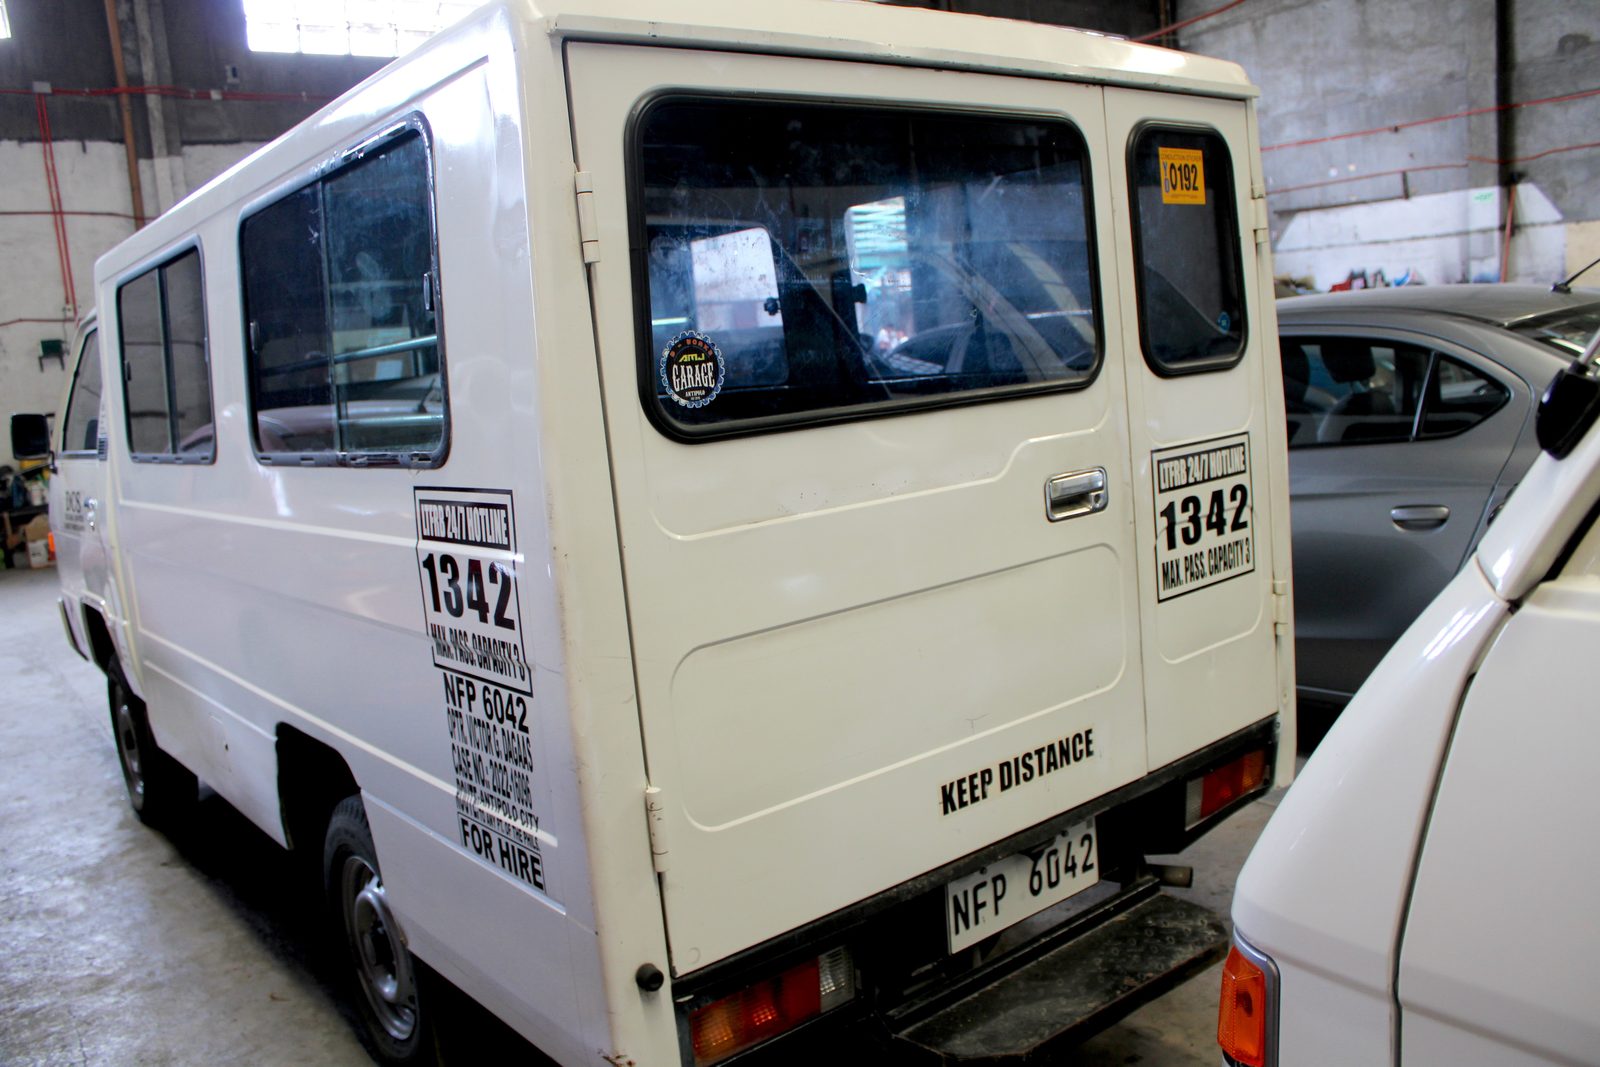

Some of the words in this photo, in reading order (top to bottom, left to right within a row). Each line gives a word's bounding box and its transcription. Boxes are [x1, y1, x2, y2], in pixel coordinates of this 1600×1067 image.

[1170, 162, 1199, 191] 0192
[672, 362, 715, 392] GARAGE
[1161, 458, 1187, 490] LTFRB
[1187, 453, 1209, 484] 24/7
[1209, 445, 1245, 479] HOTLINE
[421, 503, 447, 538] LTFRB
[446, 505, 467, 541] 24/7
[466, 506, 509, 545] HOTLINE
[1160, 483, 1248, 551] 1342
[422, 552, 516, 631] 1342
[1162, 558, 1184, 591] MAX.
[1184, 551, 1207, 584] PASS.
[1208, 538, 1244, 576] CAPACITY
[1245, 537, 1251, 564] 3
[430, 623, 454, 659] MAX.
[472, 633, 519, 679] CAPACITY
[443, 672, 476, 713] NFP
[482, 685, 530, 735] 6042
[451, 742, 473, 781] CASE
[466, 714, 495, 756] VICTOR
[501, 727, 534, 773] DAGAAS
[941, 767, 993, 816] KEEP
[998, 728, 1095, 793] DISTANCE
[480, 789, 519, 823] ANTIPOLO
[519, 808, 539, 833] CITY
[461, 817, 496, 864] FOR
[498, 837, 544, 891] HIRE
[952, 873, 1007, 936] NFP
[1029, 832, 1095, 897] 6042
